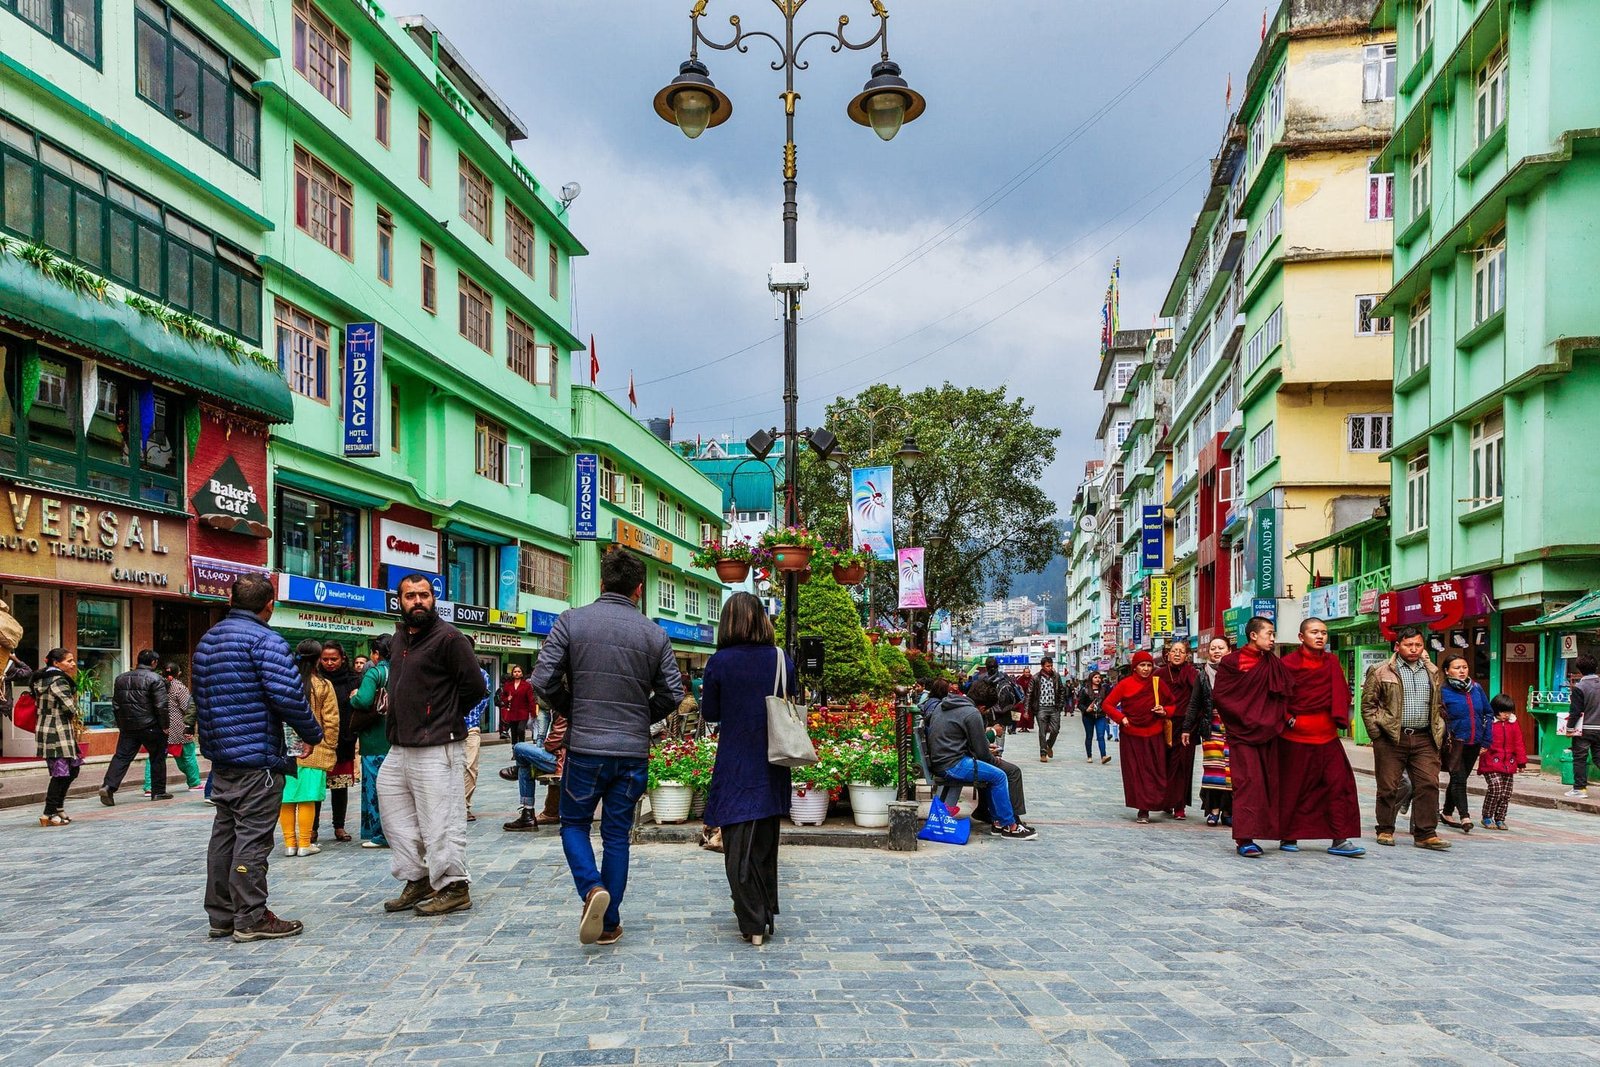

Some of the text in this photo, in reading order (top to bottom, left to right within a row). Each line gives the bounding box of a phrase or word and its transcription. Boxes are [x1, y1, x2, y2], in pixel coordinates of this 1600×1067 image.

[352, 358, 367, 426] DZONG
[210, 479, 256, 504] Baker's
[581, 476, 591, 520] DZONG
[214, 496, 249, 515] Café
[8, 491, 168, 554] VERSAL
[48, 540, 114, 564] TRADERS
[386, 535, 420, 556] Canon
[1262, 530, 1273, 590] WOODLAND
[112, 566, 168, 586] GANGTOK
[328, 590, 365, 602] Hewlett-Packard
[1158, 580, 1167, 610] house
[298, 613, 314, 621] HARI
[457, 609, 485, 622] SONY
[500, 611, 518, 624] Nikon
[1158, 612, 1167, 631] roll
[480, 632, 521, 646] CONVERSE
